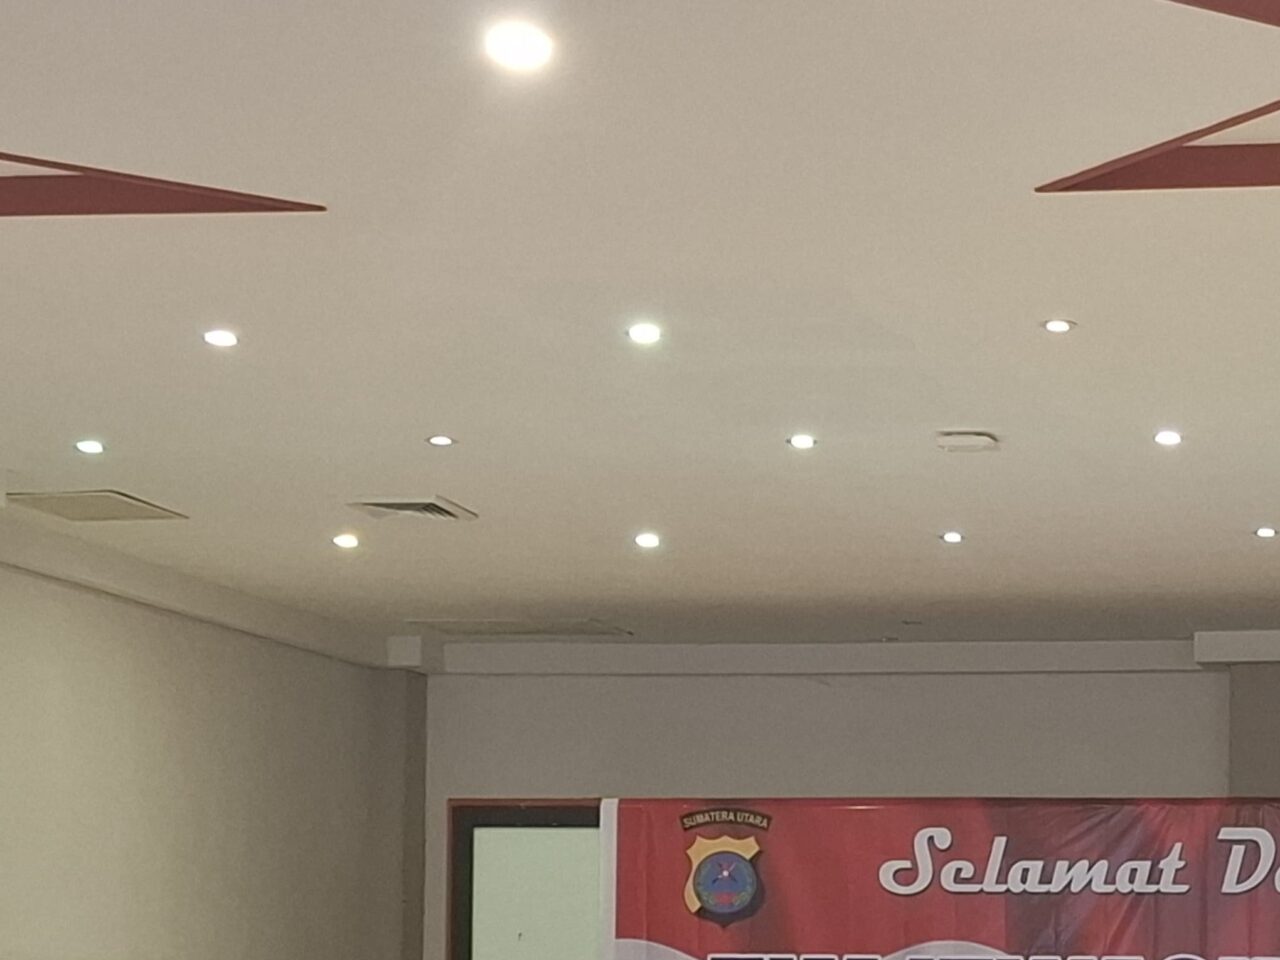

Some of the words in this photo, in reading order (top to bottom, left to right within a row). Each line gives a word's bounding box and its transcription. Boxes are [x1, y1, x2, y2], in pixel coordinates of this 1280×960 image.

[683, 811, 735, 828] SUMATERA
[736, 811, 768, 828] UTARA
[879, 827, 1191, 895] Selamat
